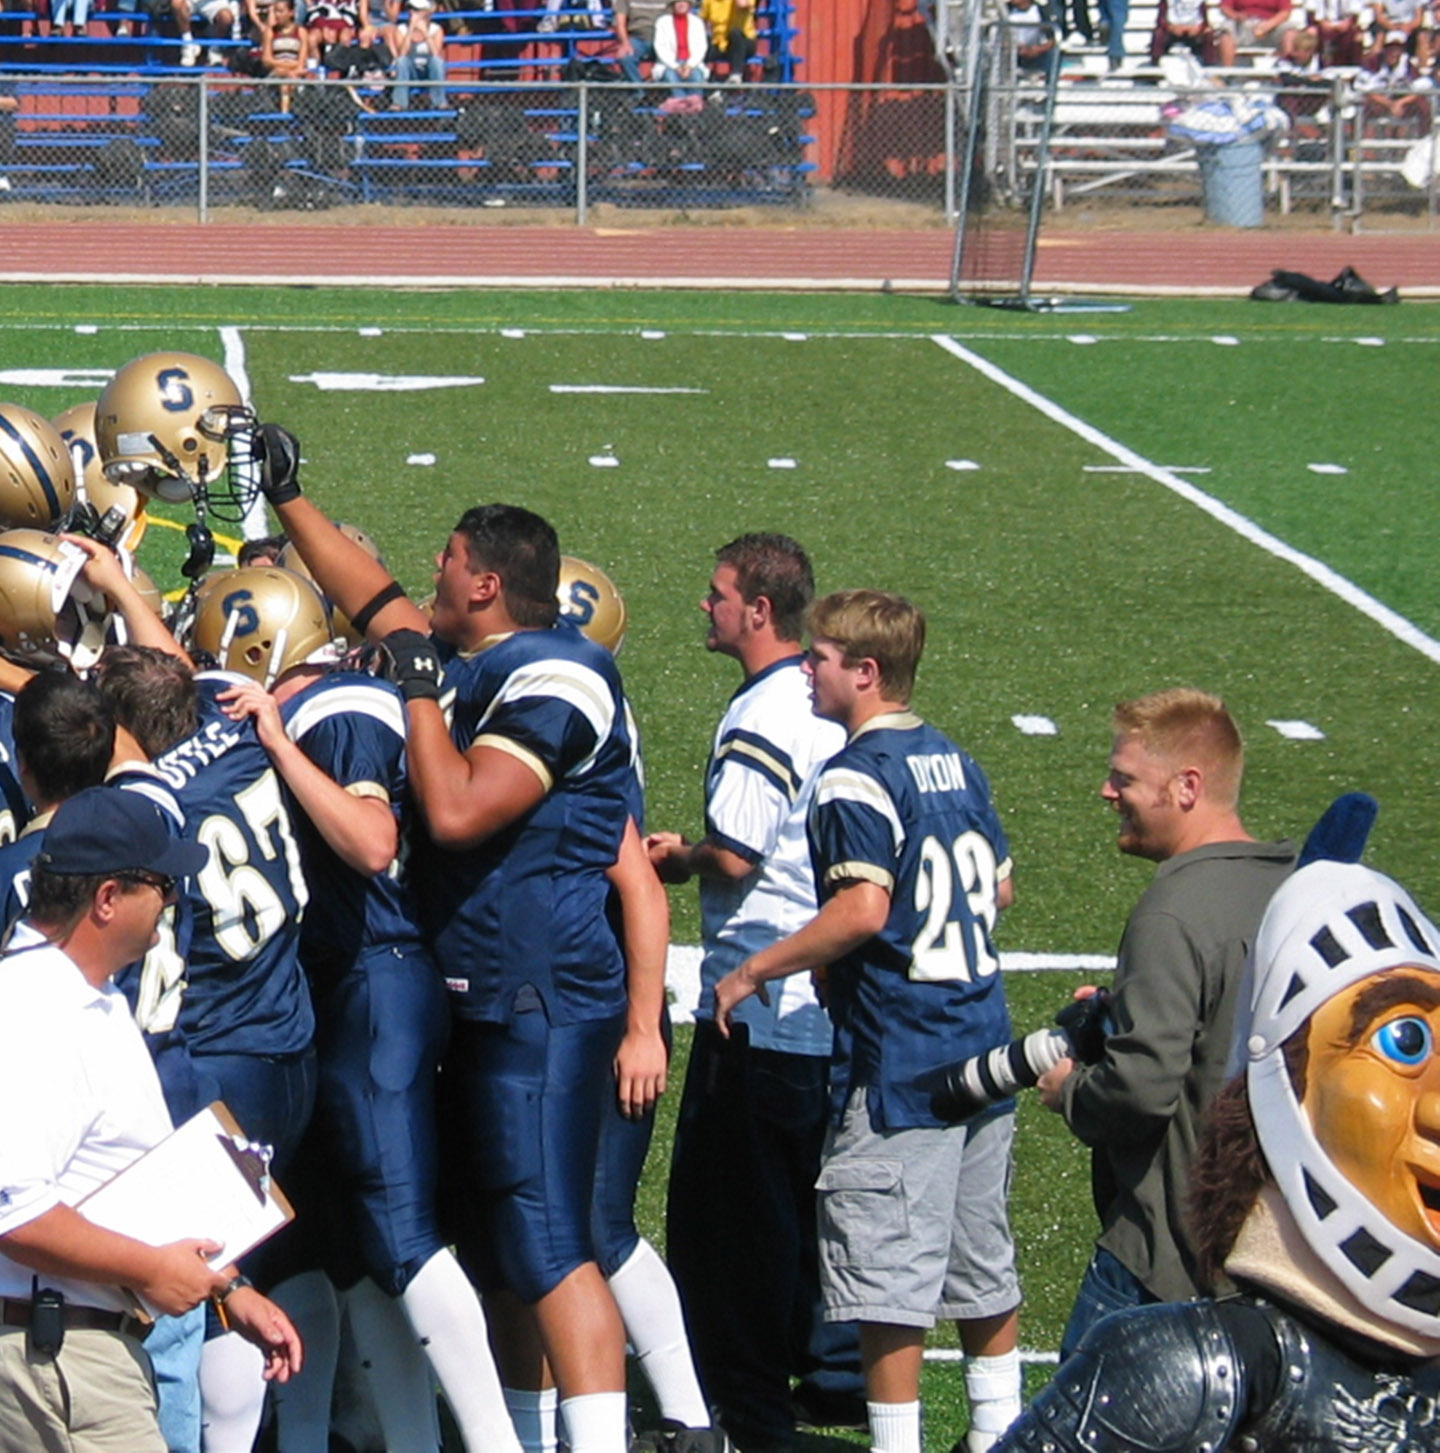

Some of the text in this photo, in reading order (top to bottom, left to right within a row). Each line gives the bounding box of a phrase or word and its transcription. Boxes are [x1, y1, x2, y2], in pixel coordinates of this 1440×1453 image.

[156, 368, 194, 412] S
[223, 589, 260, 638] S
[561, 580, 599, 626] S
[198, 768, 310, 963] 67
[909, 830, 1000, 983] 23
